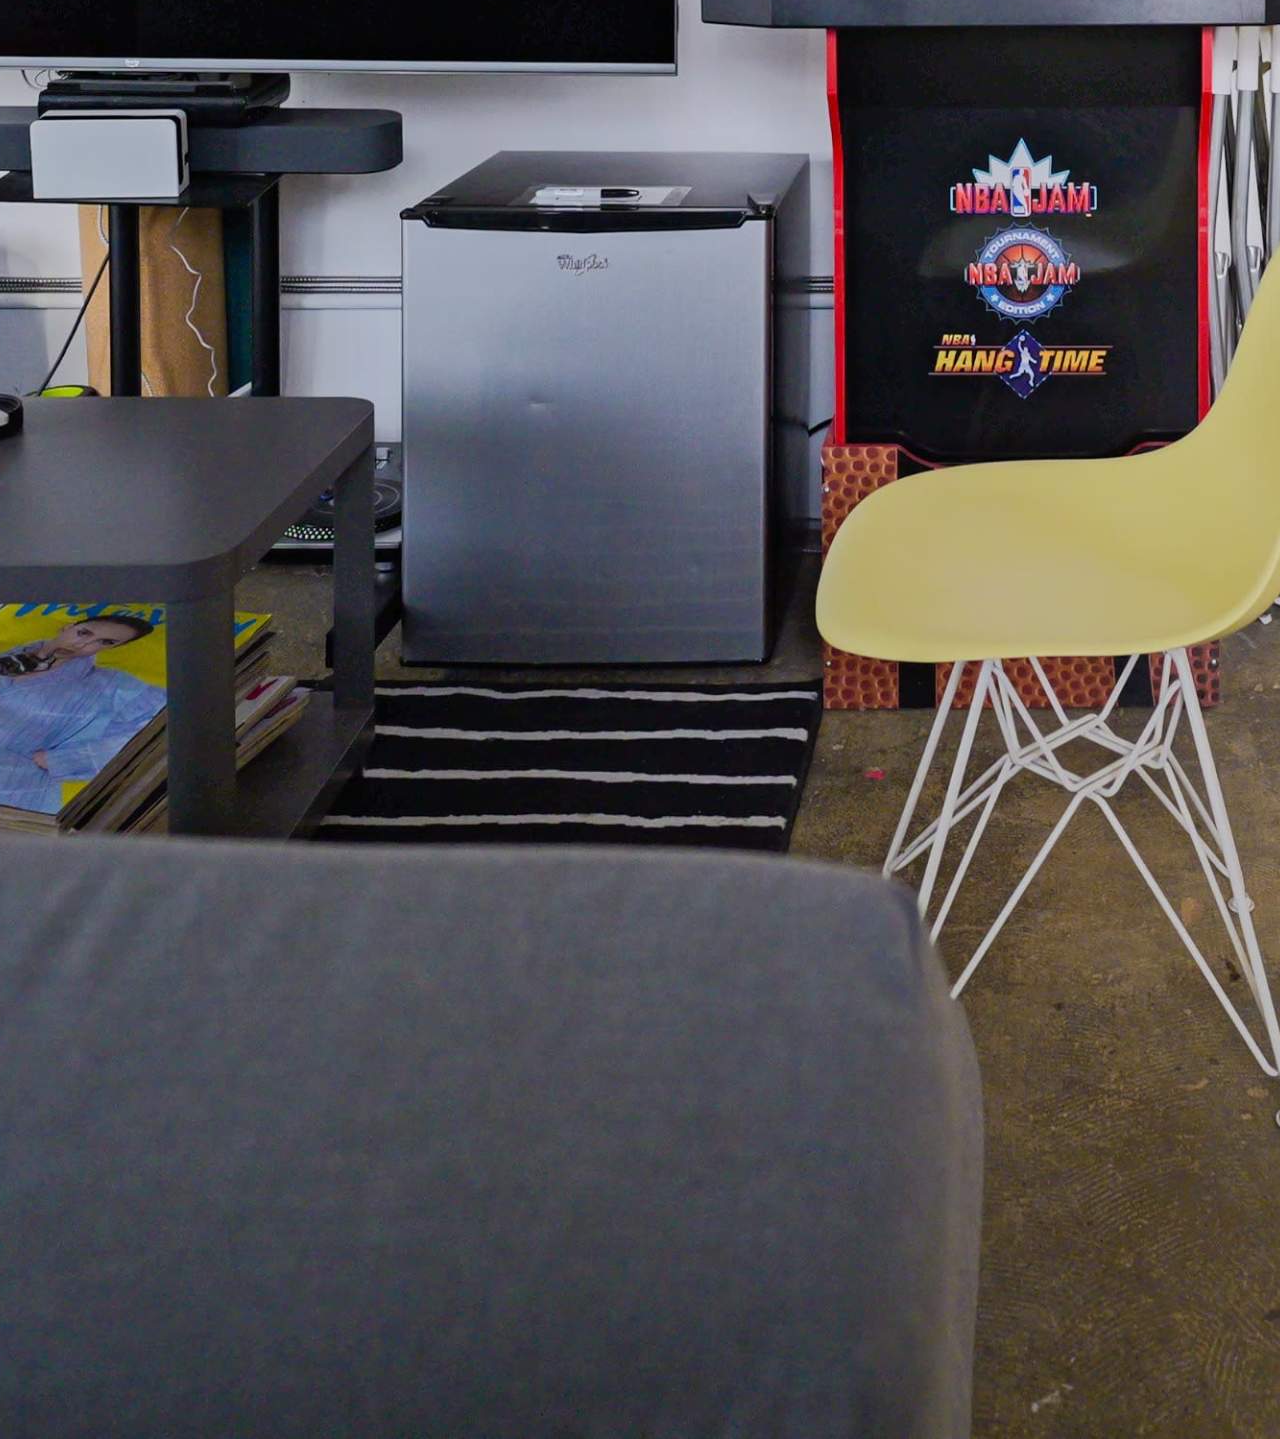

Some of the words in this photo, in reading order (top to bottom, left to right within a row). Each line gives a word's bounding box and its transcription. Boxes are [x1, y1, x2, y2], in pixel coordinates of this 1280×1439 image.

[955, 182, 1011, 214] NBA
[1031, 182, 1090, 214] JAM
[985, 232, 1060, 260] TOURNAMENT
[969, 262, 1013, 286] NBA
[1030, 262, 1076, 286] JAM
[998, 300, 1046, 314] EDITION
[941, 334, 970, 345] NBA
[935, 350, 1015, 372] HANG
[1039, 350, 1107, 372] TIME
